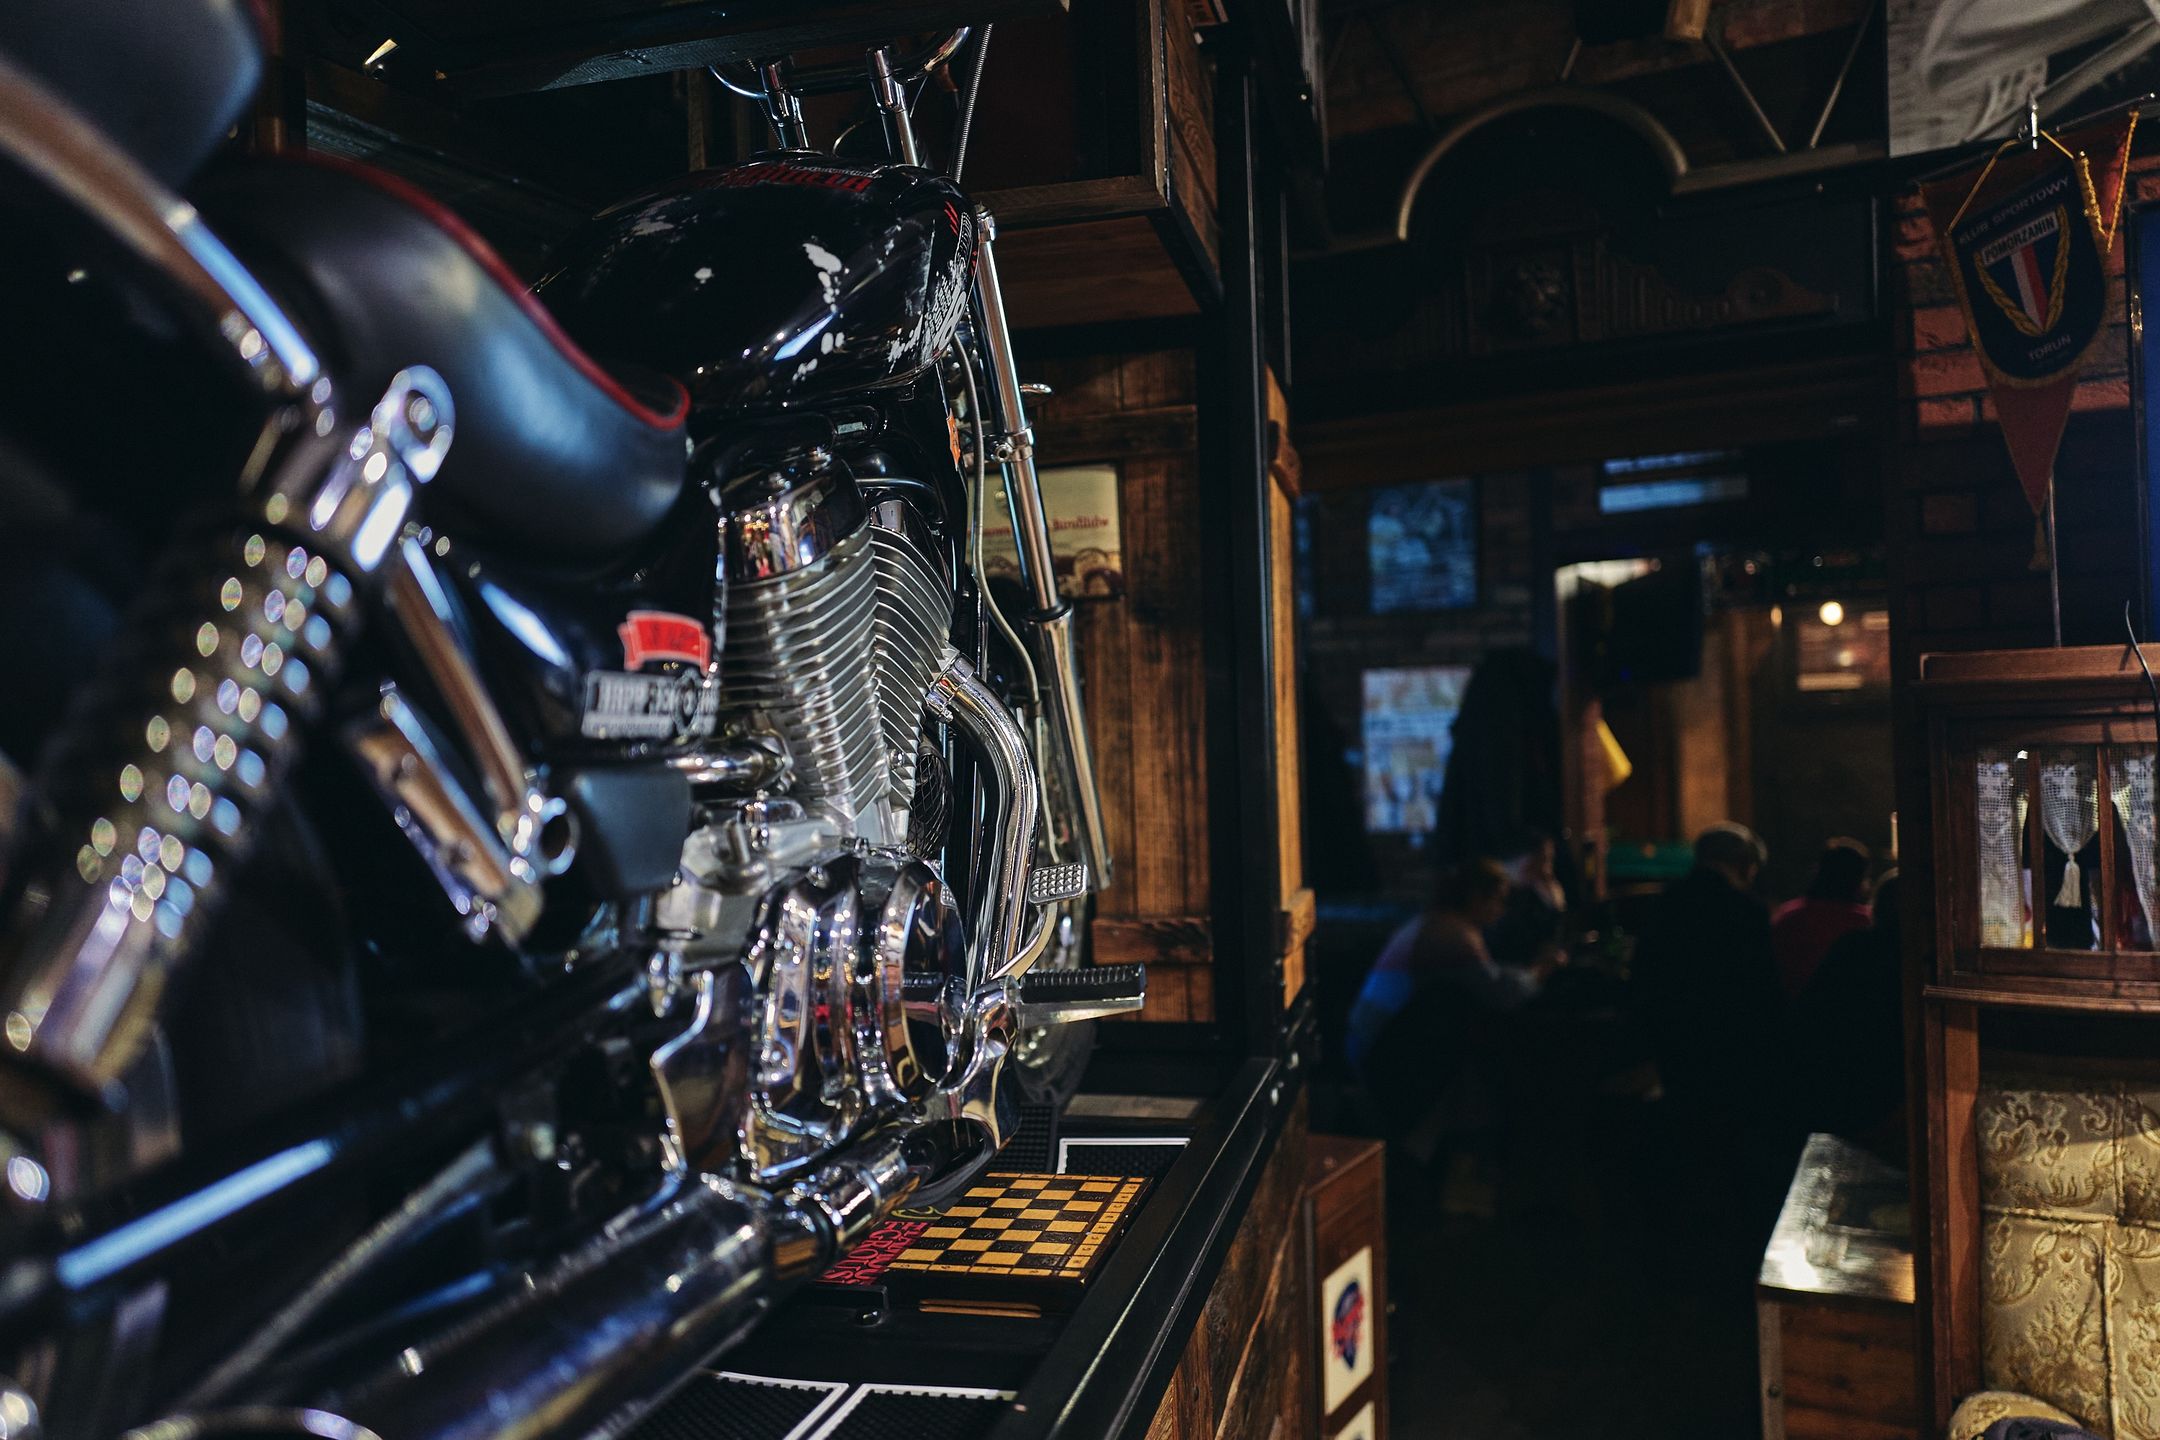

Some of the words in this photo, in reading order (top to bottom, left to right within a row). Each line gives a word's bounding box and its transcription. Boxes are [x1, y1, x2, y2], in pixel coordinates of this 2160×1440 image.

[1958, 219, 1989, 244] KLUB
[1992, 176, 2069, 226] SPORTOWY
[1984, 215, 2055, 262] POMORZANIN
[816, 1229, 902, 1284] GROUS
